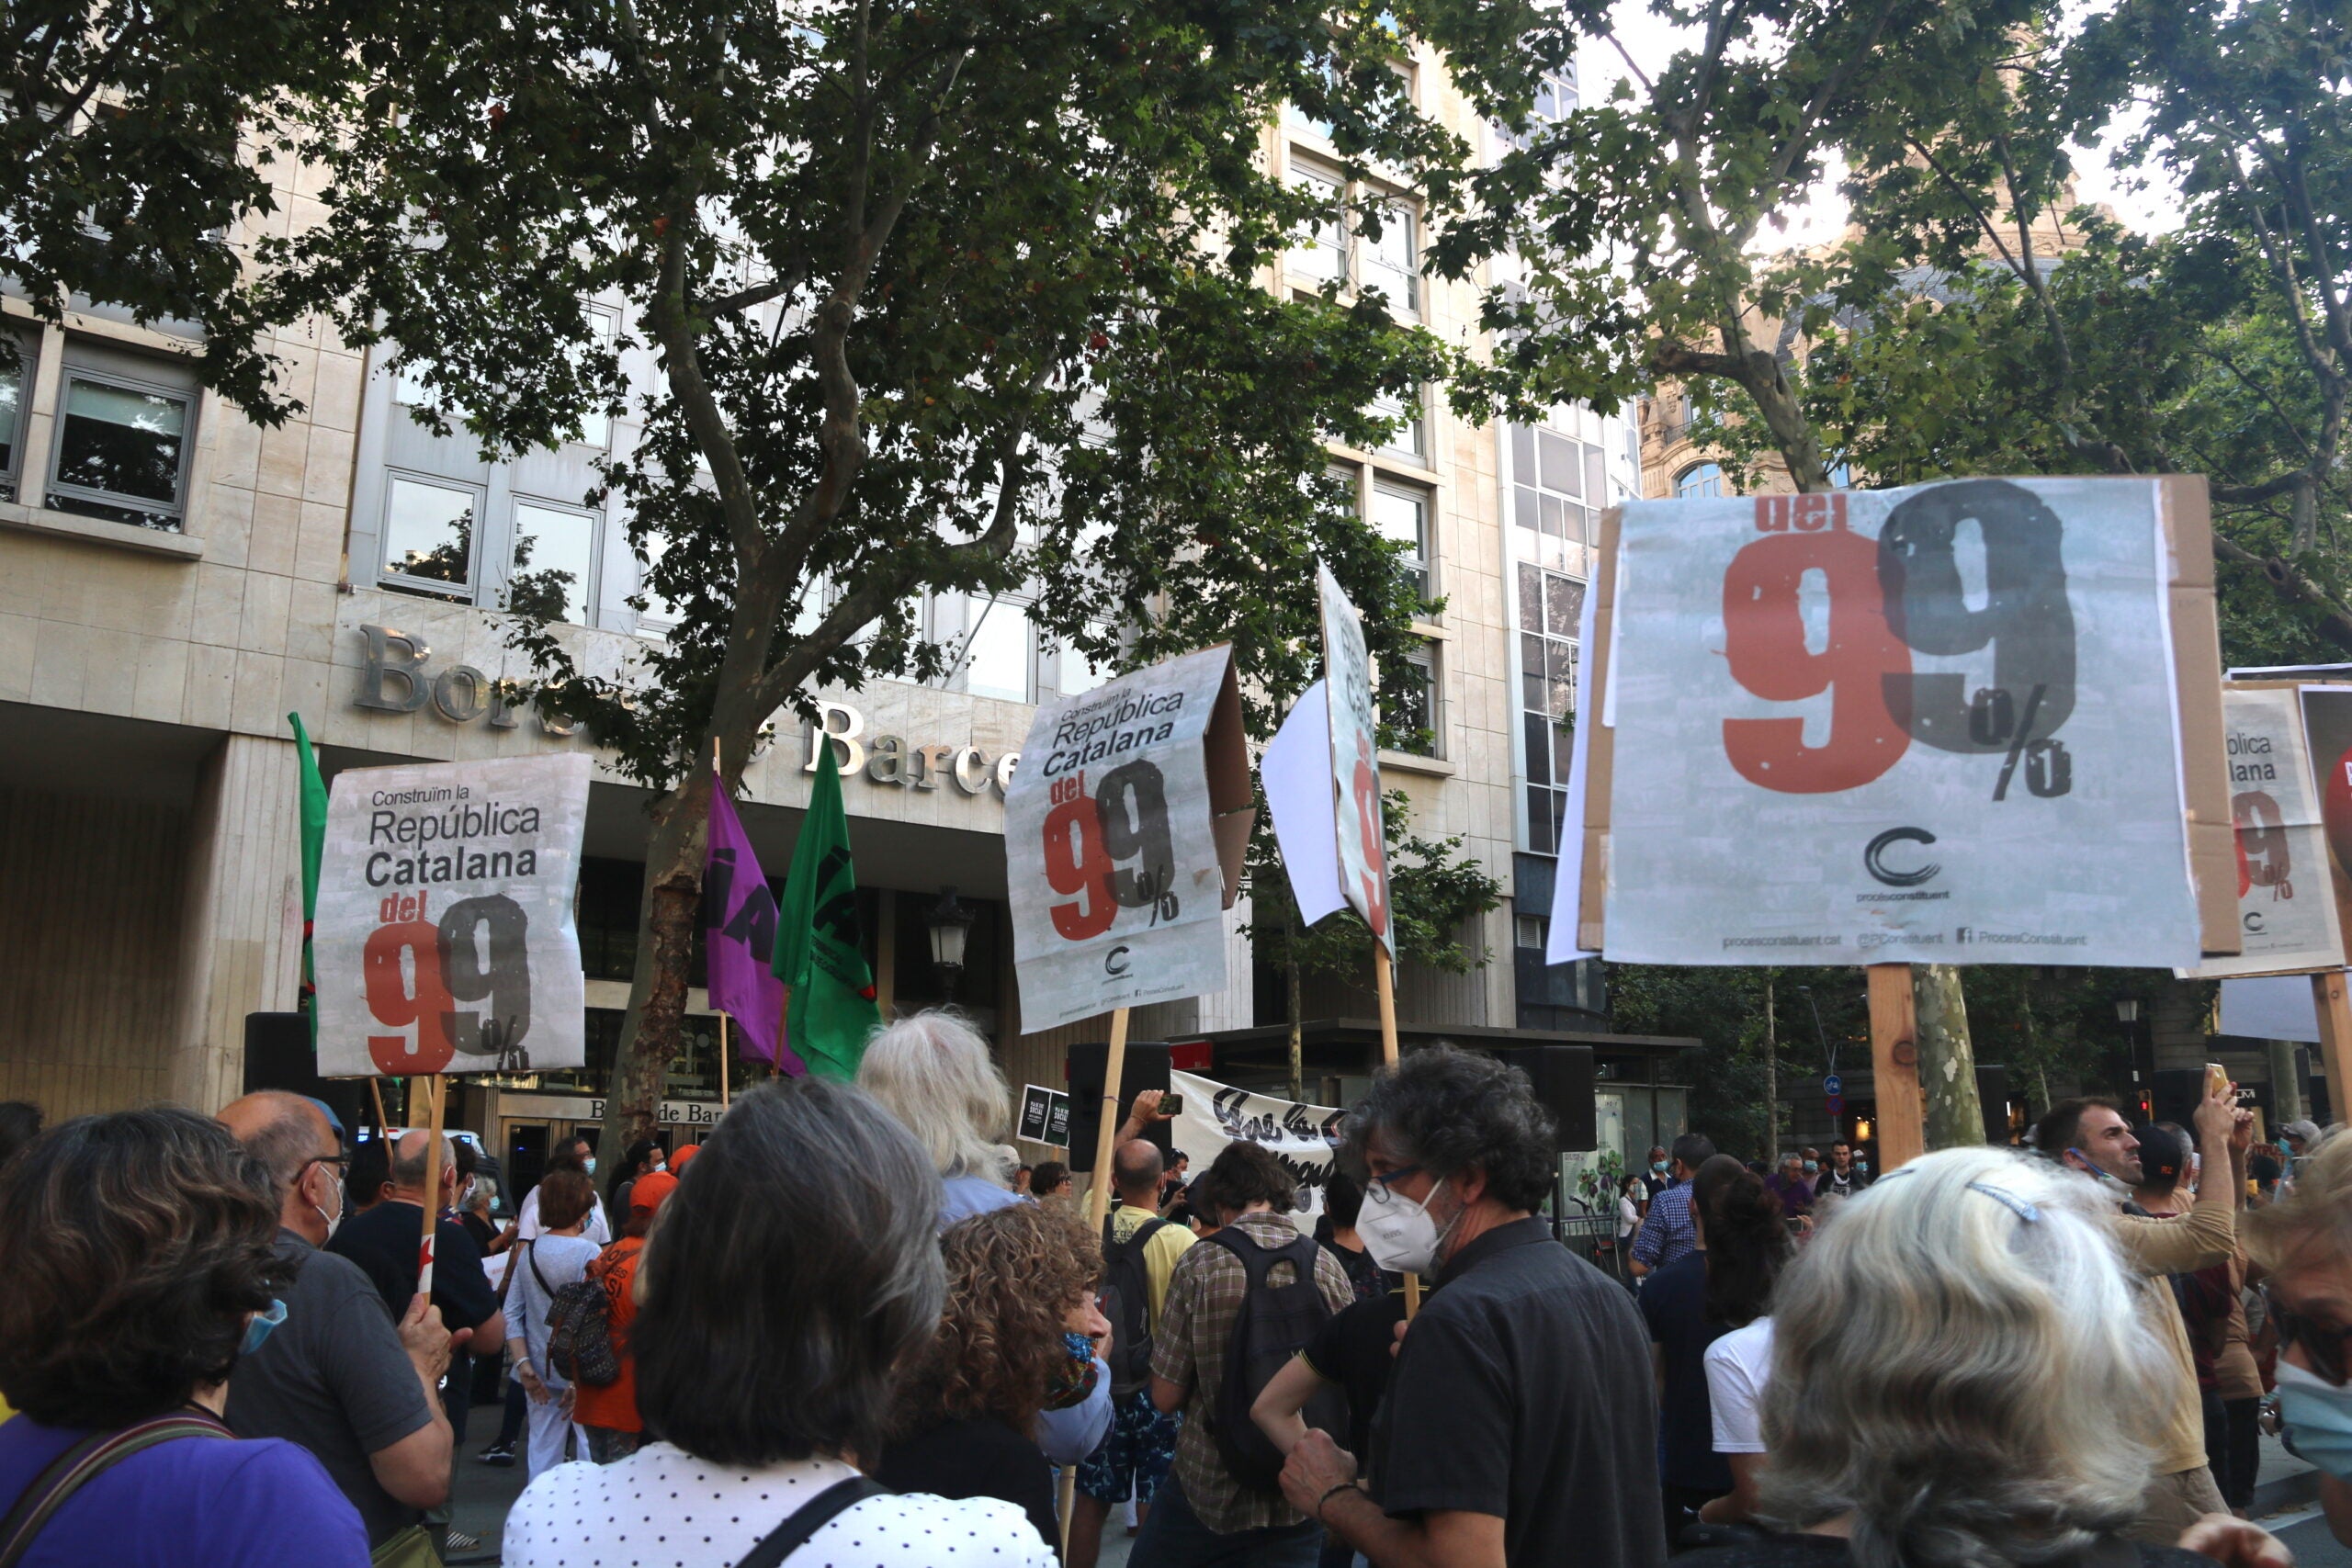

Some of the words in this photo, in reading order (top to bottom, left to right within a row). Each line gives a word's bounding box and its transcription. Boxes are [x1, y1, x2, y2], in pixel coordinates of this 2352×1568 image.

[1052, 692, 1184, 750] República
[1042, 721, 1175, 778] Catalana
[2227, 734, 2272, 757] blica
[1050, 769, 1085, 807] del
[2230, 761, 2277, 784] lana
[371, 785, 451, 807] Construïm
[456, 784, 469, 799] la
[369, 801, 540, 850] República
[365, 846, 537, 887] Catalana
[1041, 759, 1180, 942] 99%
[379, 890, 428, 923] del
[659, 1103, 680, 1122] de
